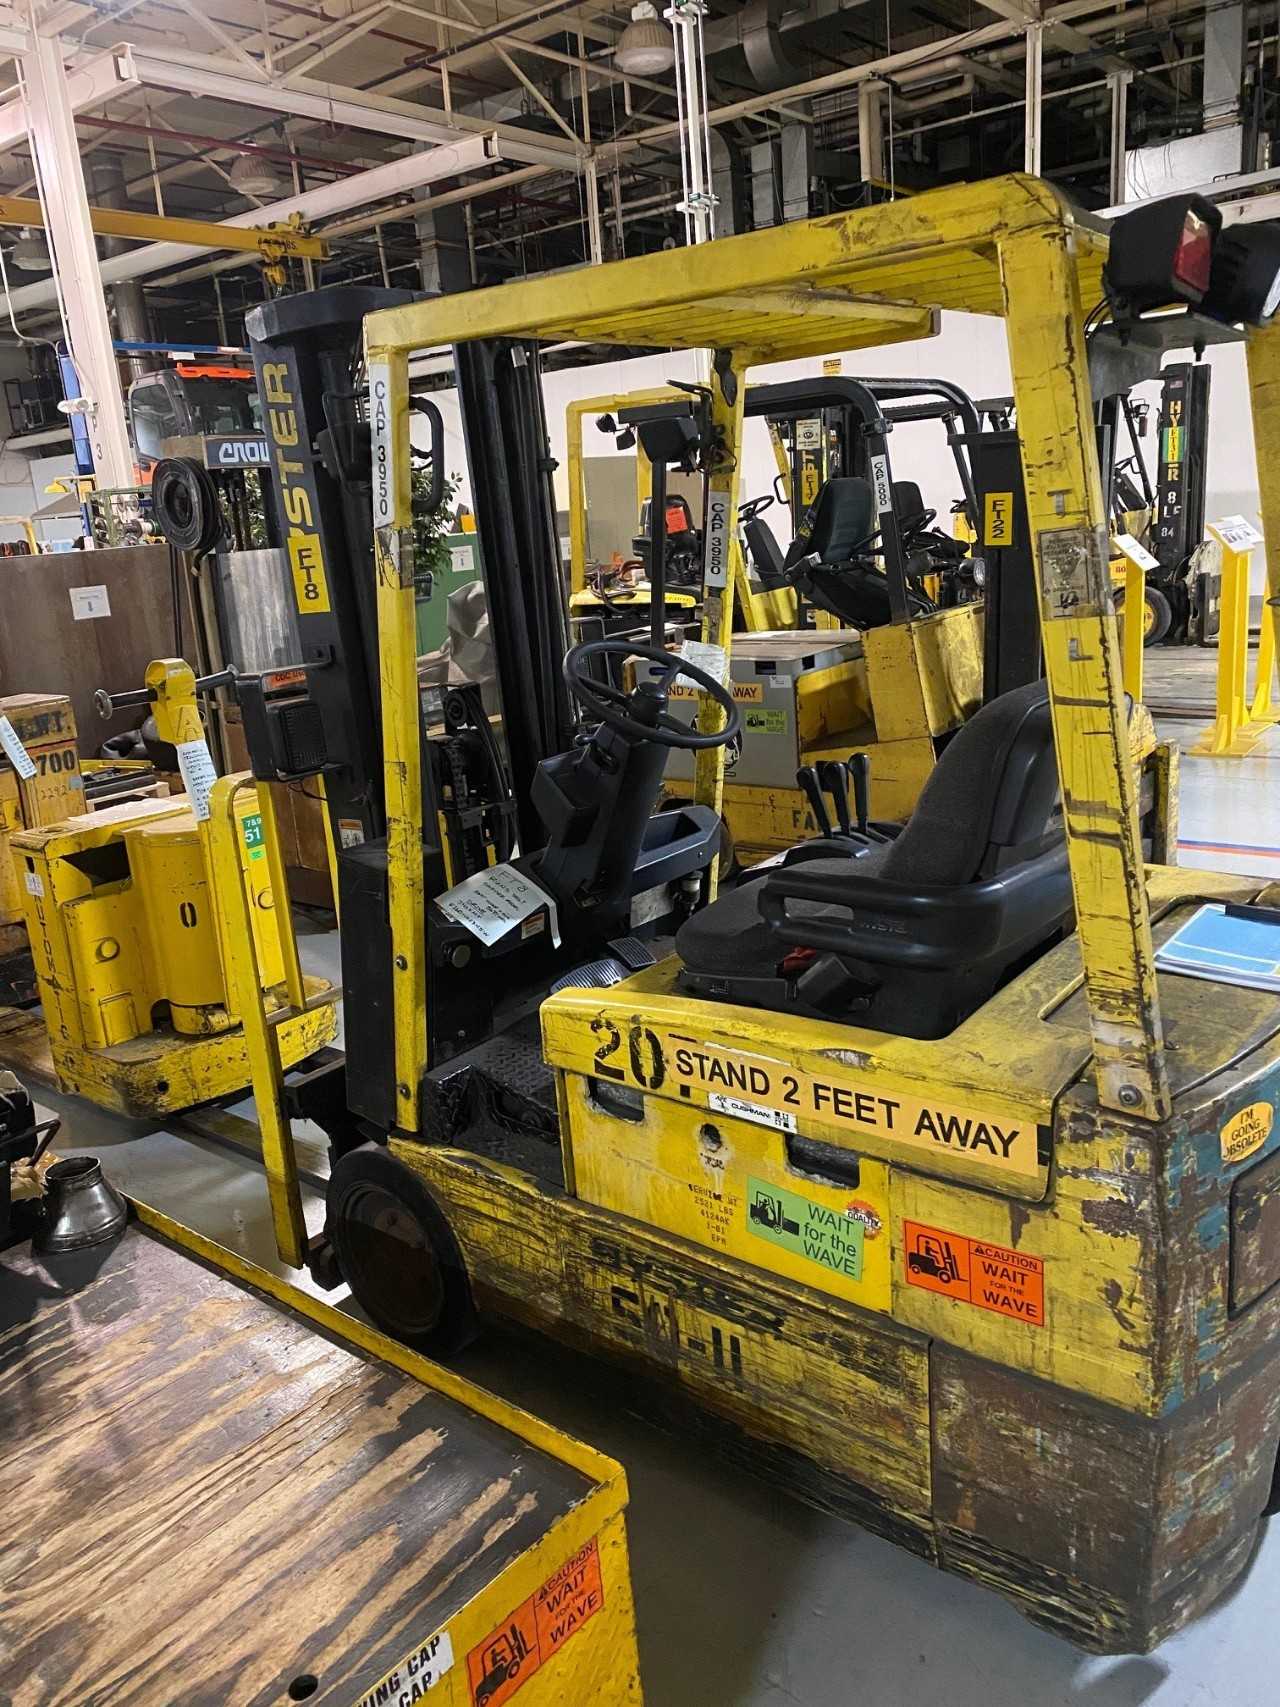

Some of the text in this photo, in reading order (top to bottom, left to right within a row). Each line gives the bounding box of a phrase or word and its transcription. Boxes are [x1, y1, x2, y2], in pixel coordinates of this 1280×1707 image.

[262, 363, 313, 534] STER
[374, 380, 388, 516] CAP 3950
[874, 461, 885, 481] CAP
[1167, 491, 1177, 504] 8
[992, 500, 1006, 538] FT22
[710, 503, 724, 574] CAP 3950
[297, 548, 320, 600] FT8
[36, 750, 76, 776] 700
[245, 827, 261, 842] 51
[676, 1049, 1020, 1159] STAND 2 FEET AWAY
[731, 1103, 771, 1119] CUSHMAN
[1231, 1118, 1261, 1141] GOING
[808, 1203, 854, 1235] WAIT
[804, 1223, 856, 1257] for the
[803, 1240, 855, 1276] WAVE
[982, 1261, 1029, 1286] WAIT
[985, 1247, 1038, 1271] CAUTION
[983, 1289, 1038, 1318] WAVE
[989, 1280, 1024, 1296] FOR THE
[548, 1543, 593, 1591] CAUTION
[547, 1565, 587, 1613] WAIT
[550, 1590, 598, 1643] WAVE
[407, 1635, 440, 1677] CAP
[399, 1671, 432, 1707] CAP
